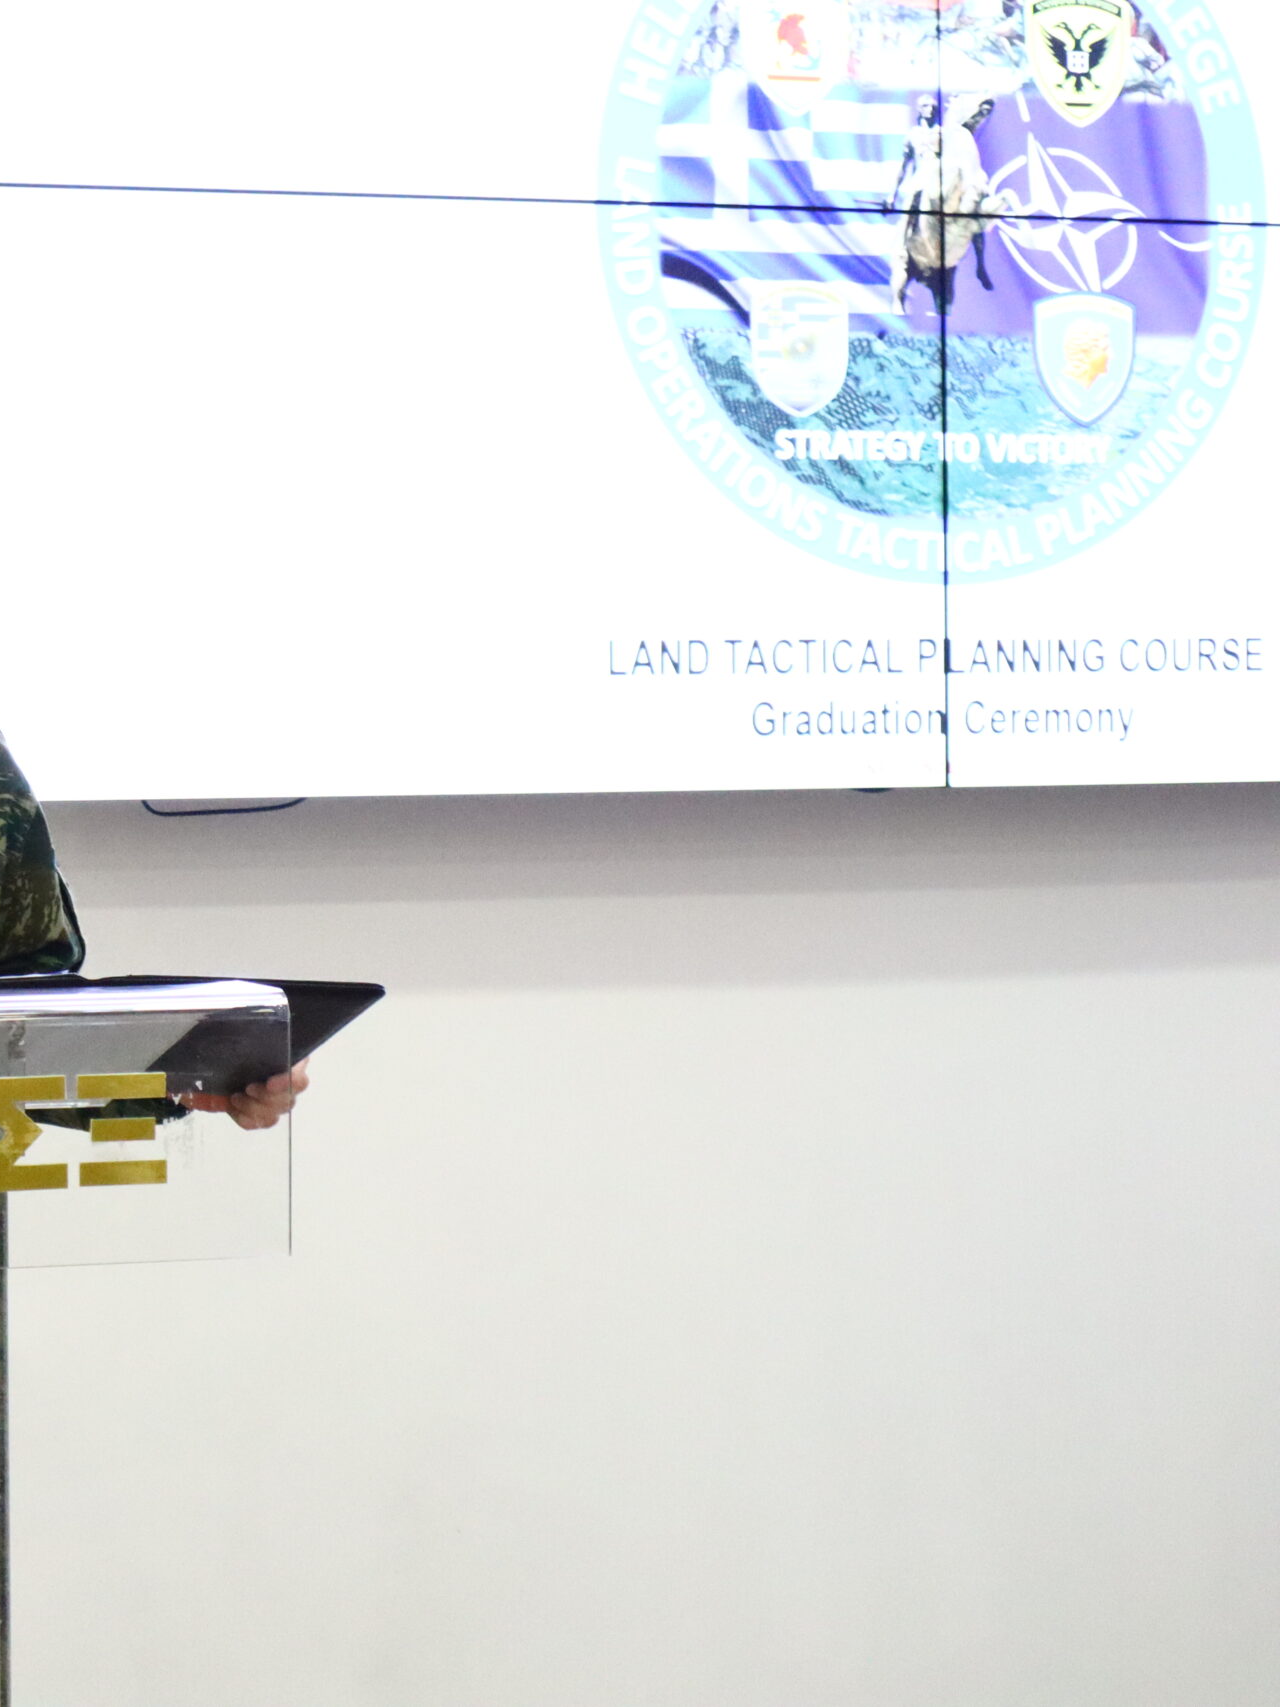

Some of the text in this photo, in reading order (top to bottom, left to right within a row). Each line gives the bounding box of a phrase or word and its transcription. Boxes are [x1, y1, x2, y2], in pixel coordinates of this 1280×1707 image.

[618, 0, 1241, 115] HEL LEGE
[611, 156, 1255, 574] LAND OPERATIONS TACTICAL PLANNING COURSE
[774, 429, 1112, 464] STRATEGY TO VICTORY
[609, 637, 1265, 676] LAND TACTICAL PLANNING COURSE
[751, 699, 1134, 741] Graduation Ceremony
